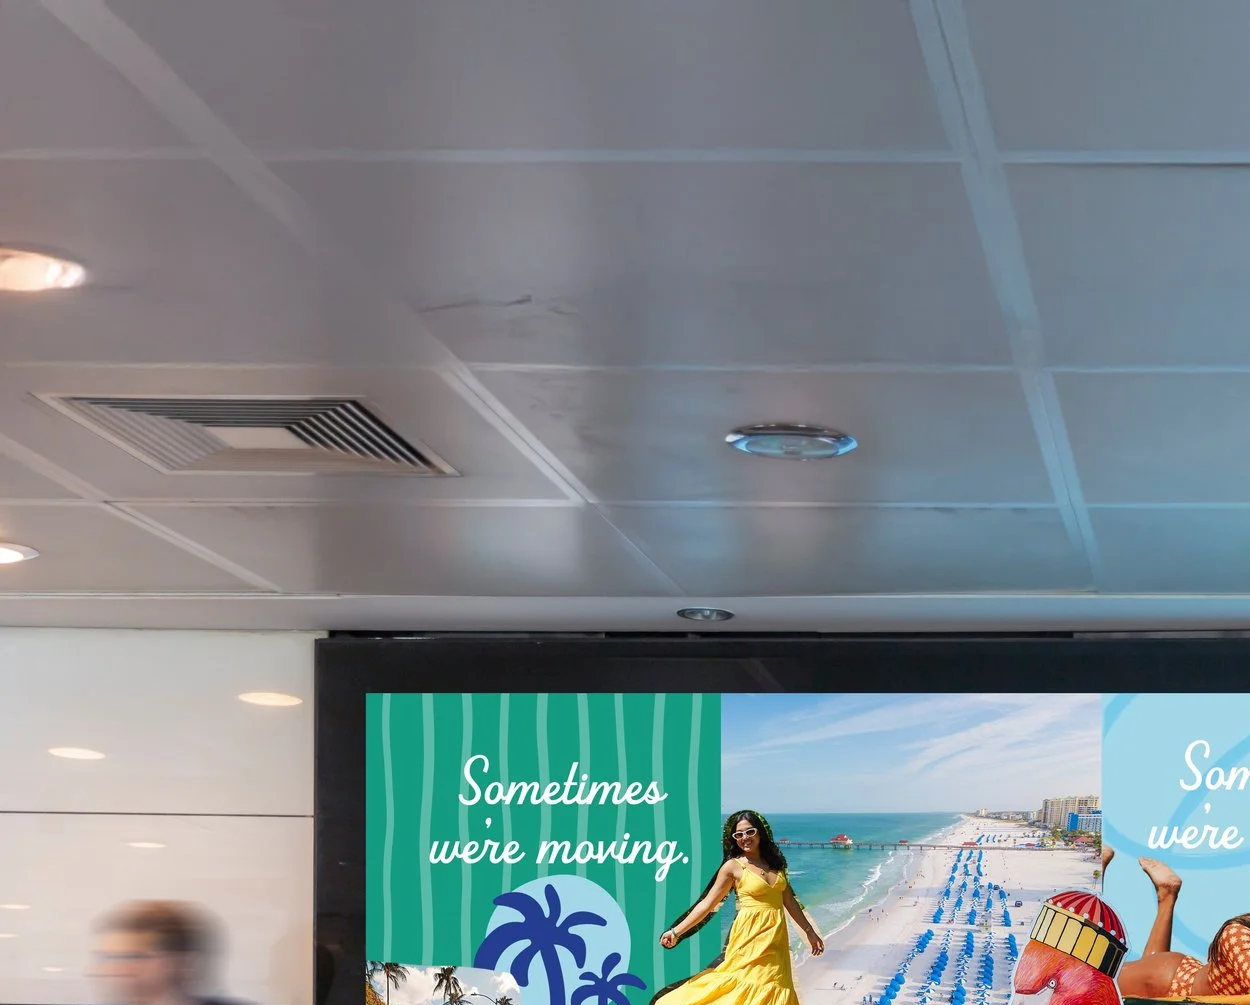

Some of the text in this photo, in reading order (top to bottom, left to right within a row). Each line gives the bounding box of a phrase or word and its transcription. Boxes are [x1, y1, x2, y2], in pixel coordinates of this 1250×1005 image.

[458, 754, 669, 807] Sometimes
[429, 817, 690, 883] we're moving.
[1147, 803, 1245, 851] we're
